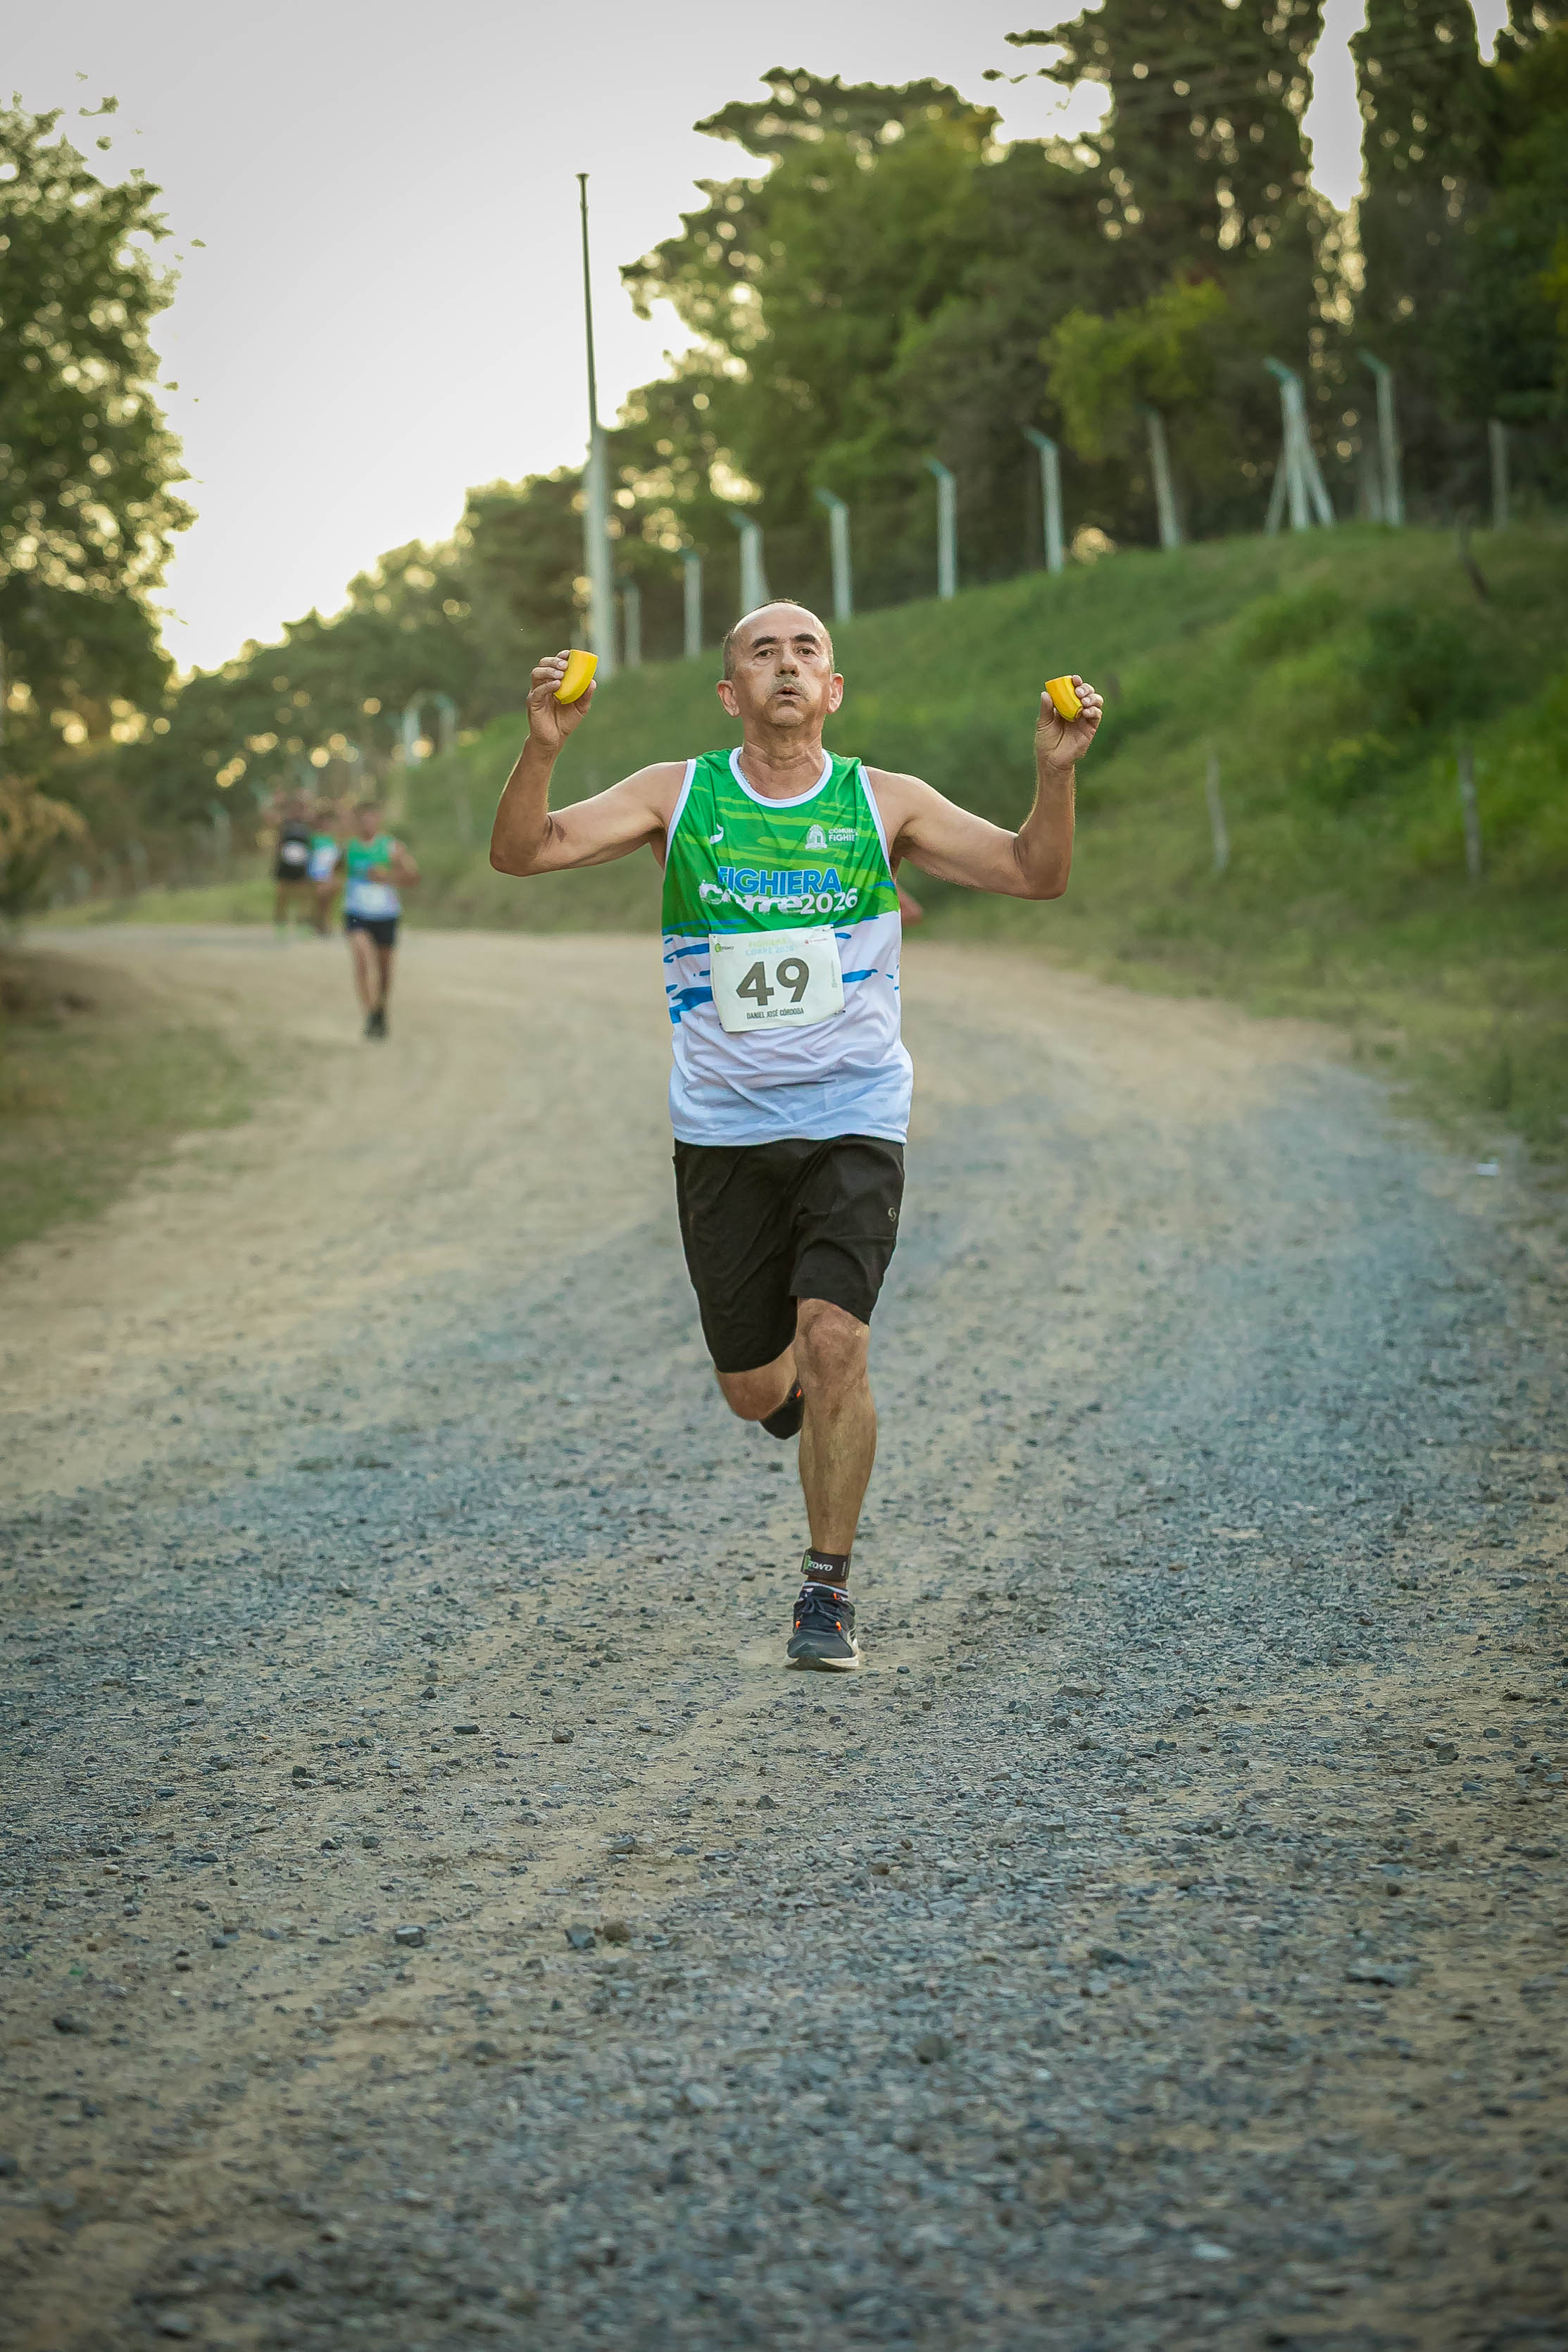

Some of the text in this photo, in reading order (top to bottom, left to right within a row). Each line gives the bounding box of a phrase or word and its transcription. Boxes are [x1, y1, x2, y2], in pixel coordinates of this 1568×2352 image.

[717, 866, 841, 896] FIGHIERA
[736, 957, 810, 1006] 49
[766, 1008, 779, 1018] JOSÉ
[779, 1007, 804, 1016] CÓRDOBA
